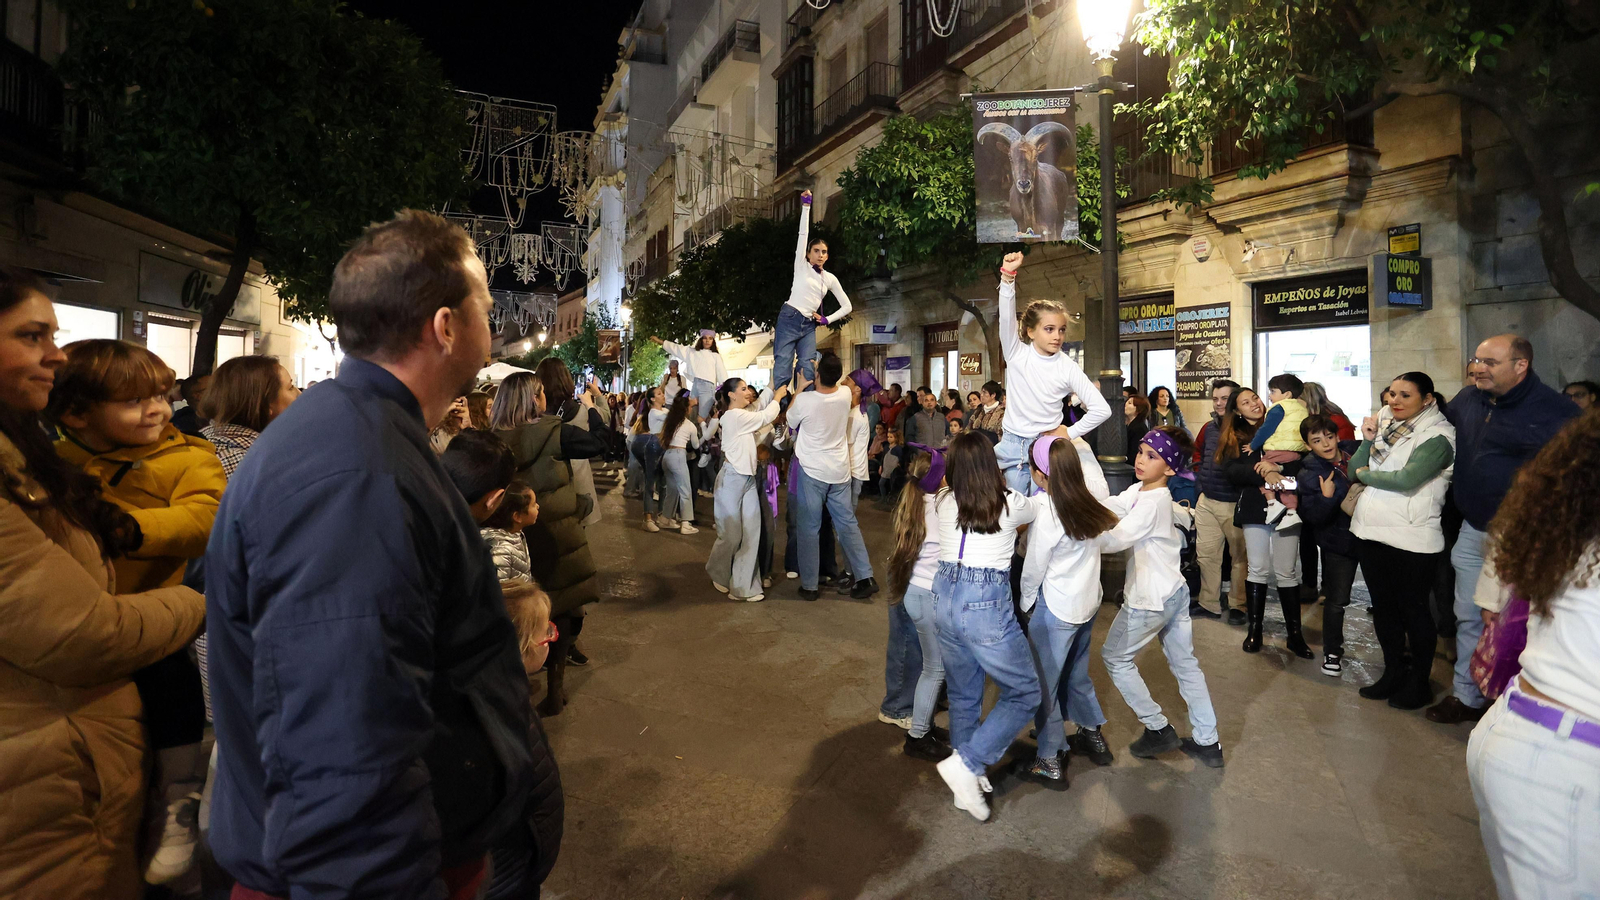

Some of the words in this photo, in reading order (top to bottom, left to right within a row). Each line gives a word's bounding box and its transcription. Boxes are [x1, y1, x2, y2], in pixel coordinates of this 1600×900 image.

[1388, 258, 1420, 274] COMPRO
[1396, 276, 1413, 291] ORO
[1263, 286, 1321, 304] EMPEÑOS
[1322, 285, 1336, 299] de
[1336, 284, 1367, 300] Joyas
[1140, 303, 1174, 318] ORO/PLAT
[1308, 304, 1317, 312] en
[1317, 300, 1349, 311] Tasación
[1176, 307, 1229, 321] OROJEREZ
[1119, 317, 1174, 334] ROJEREZ
[1177, 322, 1199, 331] COMPRO
[1176, 381, 1204, 391] PAGAMOS
